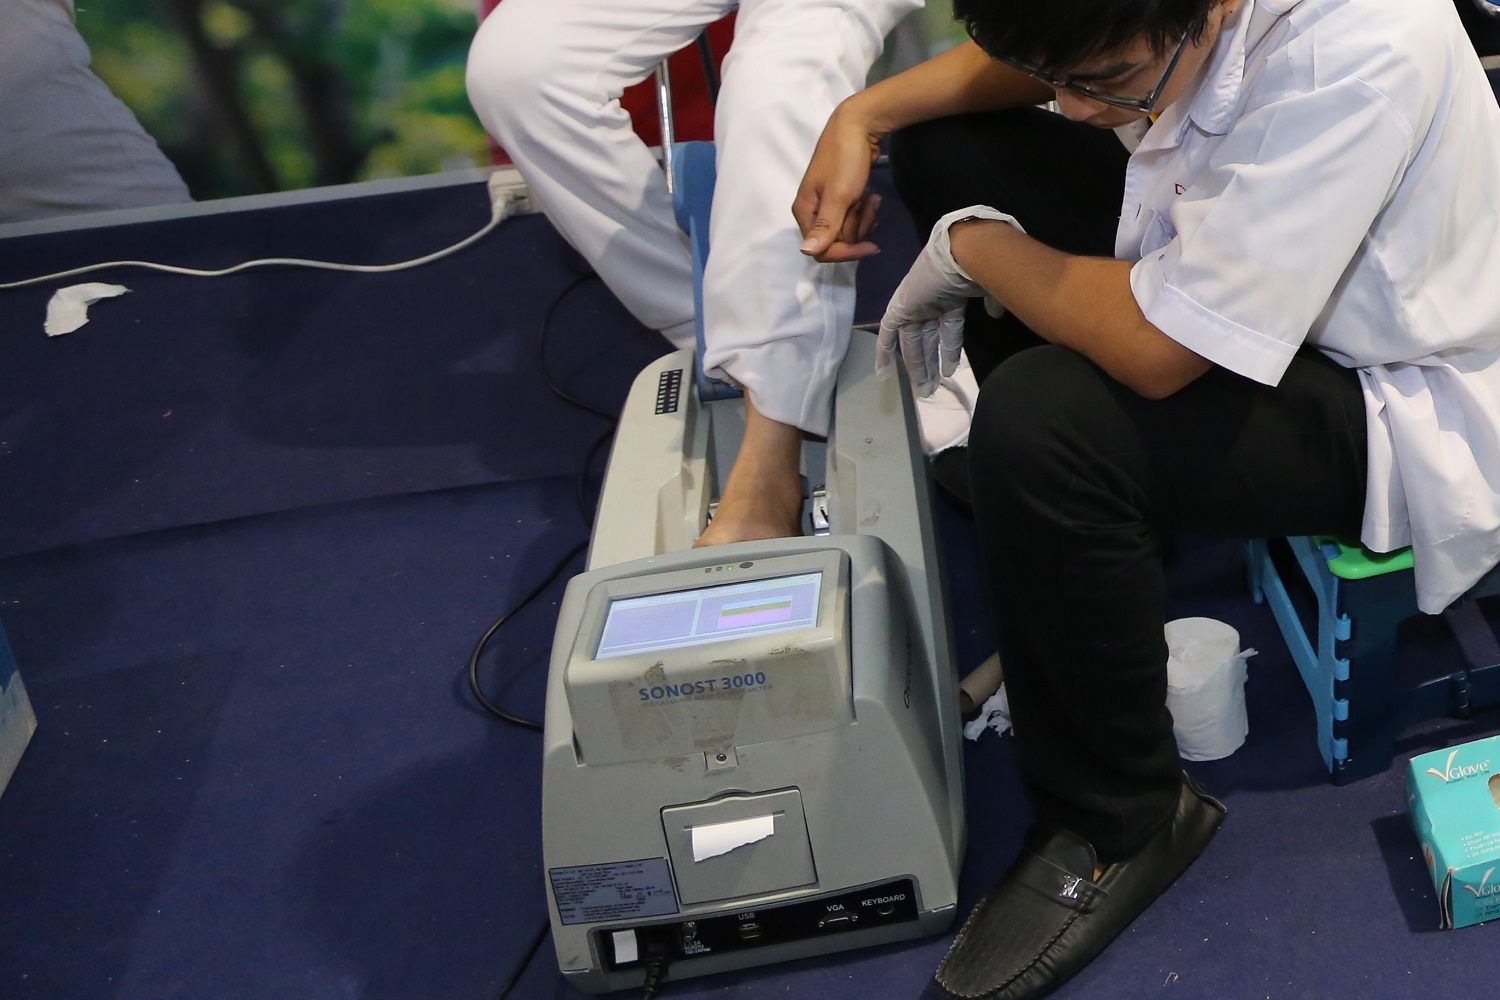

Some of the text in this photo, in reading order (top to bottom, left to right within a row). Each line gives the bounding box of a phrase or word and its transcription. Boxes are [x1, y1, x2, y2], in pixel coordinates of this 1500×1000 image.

[638, 671, 767, 701] SONOST 3000
[861, 893, 906, 907] KEYBOARD
[826, 903, 845, 912] VGA
[738, 912, 755, 920] USB
